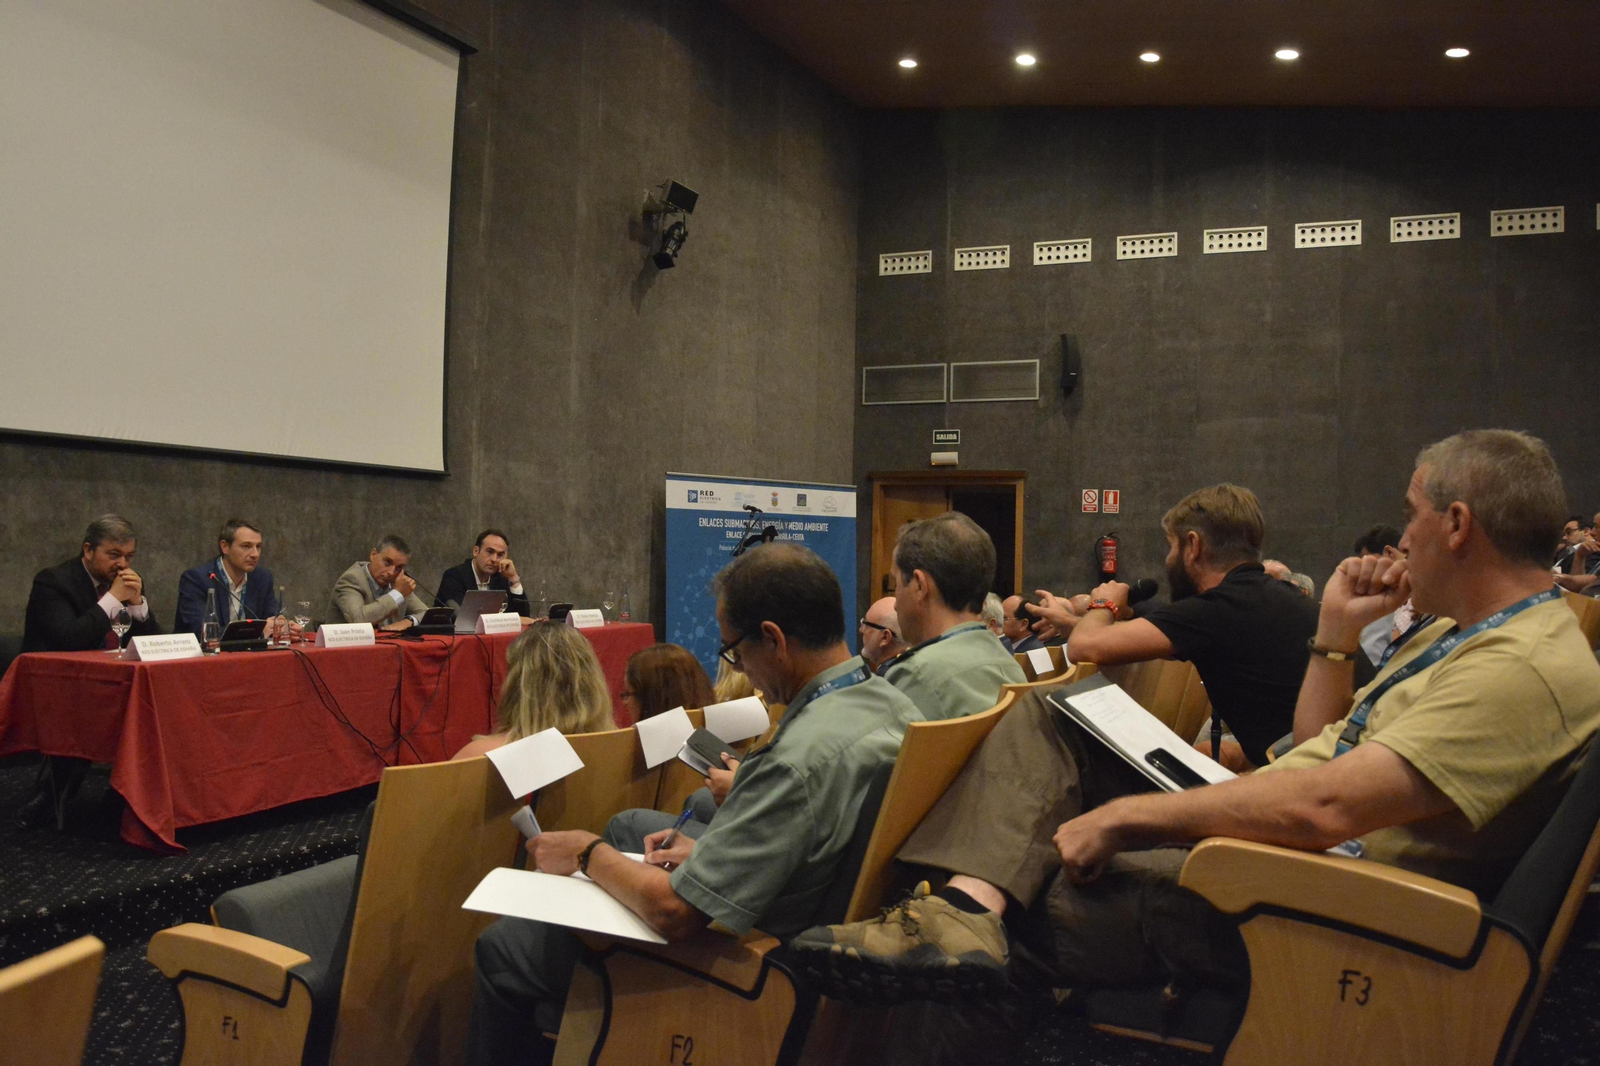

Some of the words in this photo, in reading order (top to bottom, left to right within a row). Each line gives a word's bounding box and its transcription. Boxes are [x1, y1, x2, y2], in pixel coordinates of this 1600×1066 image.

[699, 517, 723, 528] ENLACES
[784, 521, 788, 530] Y
[788, 522, 804, 531] MEDIO
[804, 522, 829, 532] AMBIENTE
[726, 530, 743, 539] ENLACE
[1338, 969, 1372, 1006] F3
[222, 1015, 240, 1040] F1
[670, 1034, 694, 1066] F2
